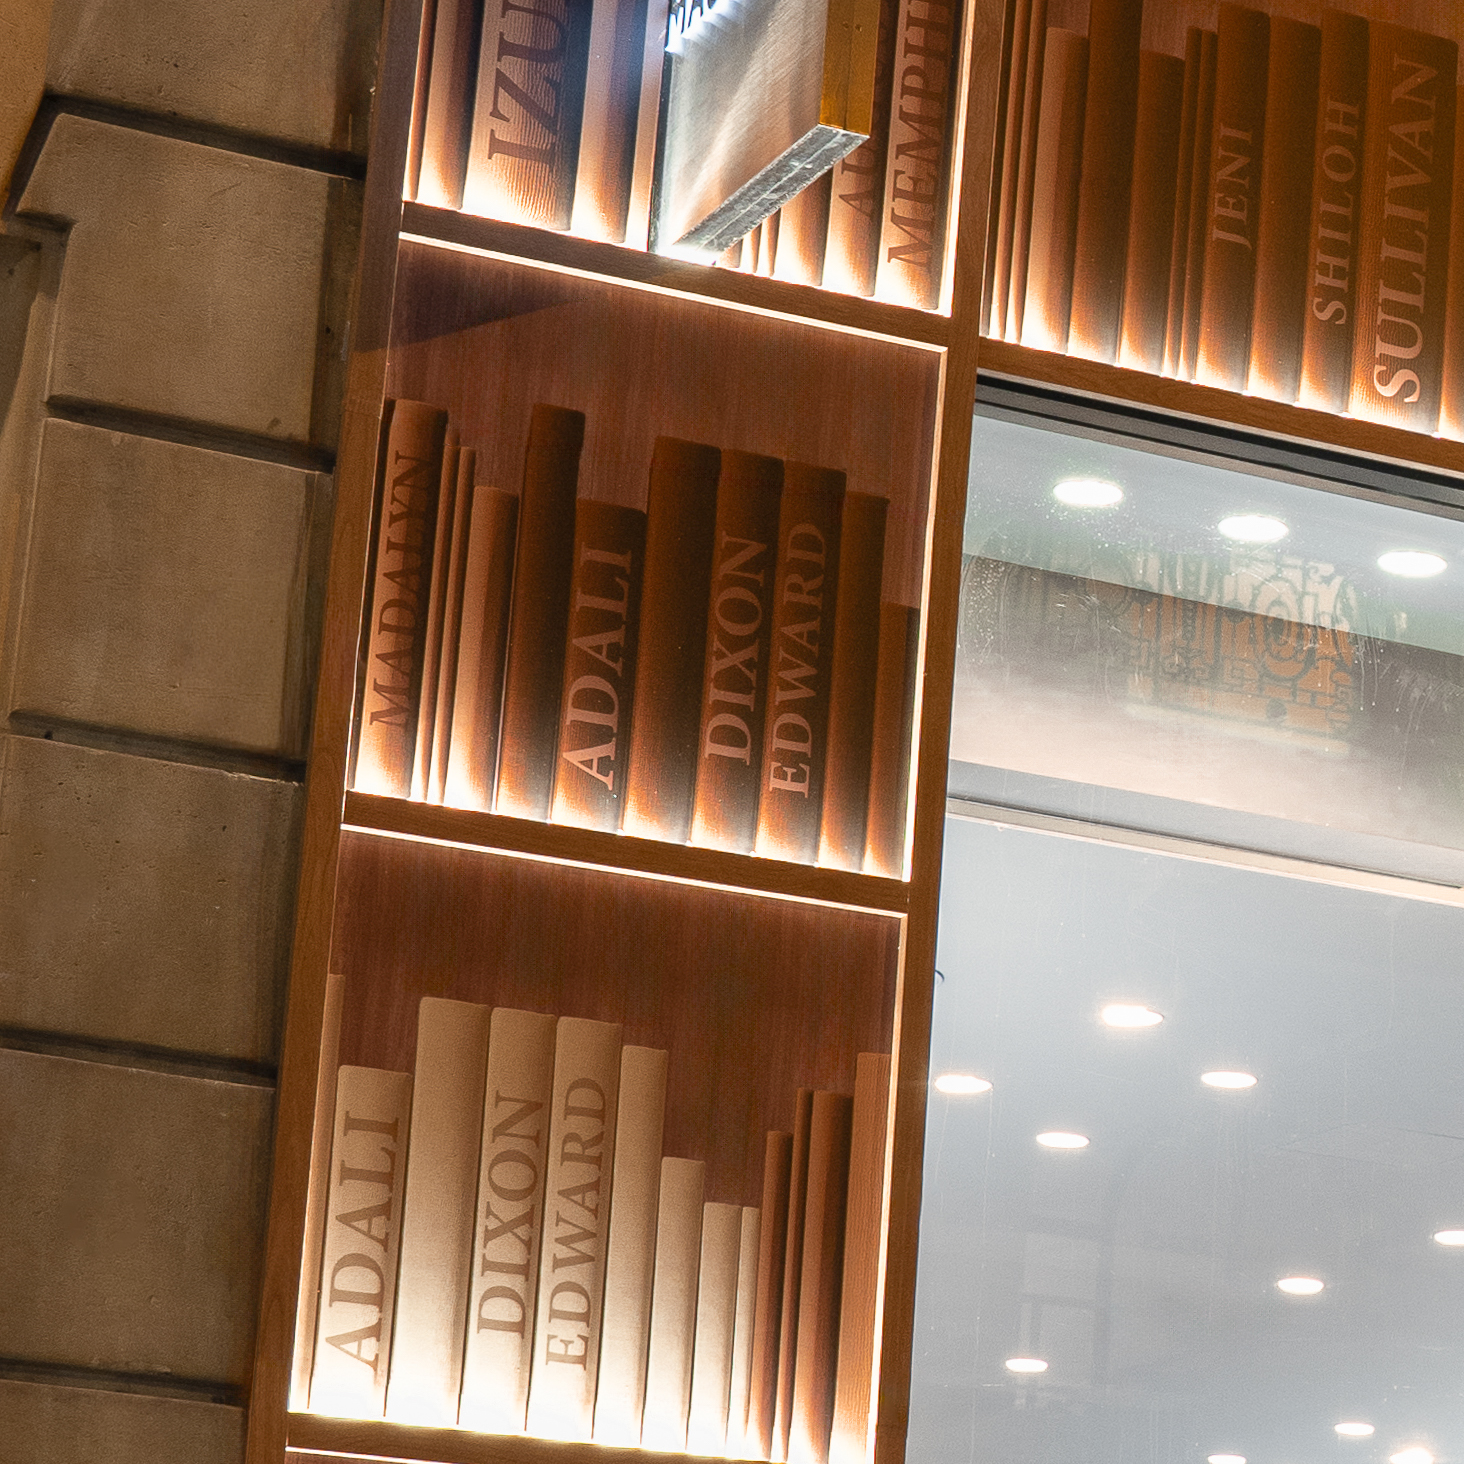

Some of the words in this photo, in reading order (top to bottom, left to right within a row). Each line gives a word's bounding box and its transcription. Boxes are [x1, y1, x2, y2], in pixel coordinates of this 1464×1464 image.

[1213, 122, 1253, 250] JENI
[1312, 95, 1359, 326] SHILOH
[1373, 52, 1438, 404] SULLIVAN
[370, 451, 432, 728] MADALYN
[561, 542, 633, 792] ADALI
[704, 531, 767, 766] DIXON
[768, 522, 827, 798] EDWARD
[325, 1111, 399, 1372] ADALI
[476, 1090, 544, 1340] DIXON
[545, 1076, 606, 1371] EDWARD
